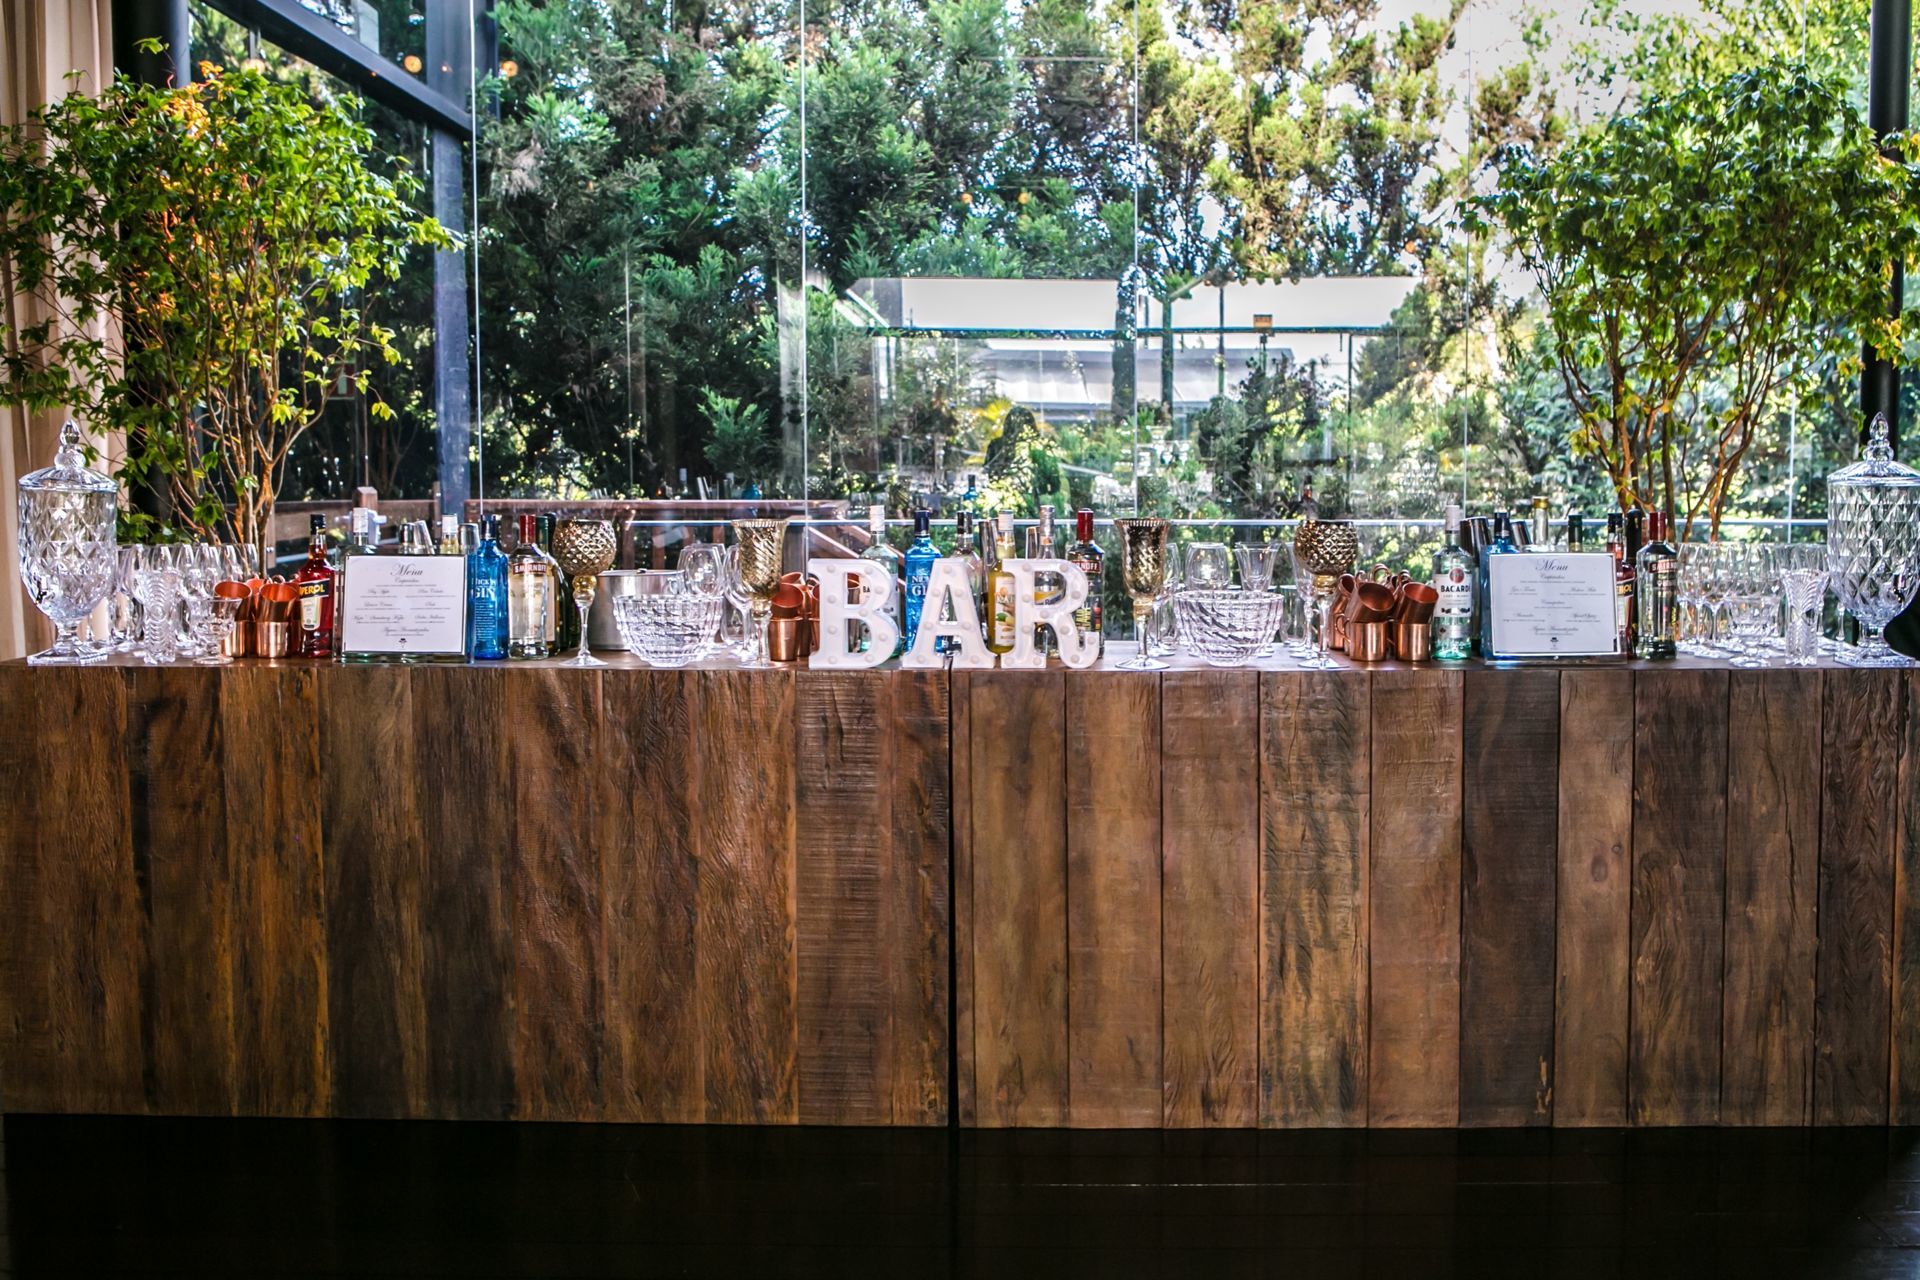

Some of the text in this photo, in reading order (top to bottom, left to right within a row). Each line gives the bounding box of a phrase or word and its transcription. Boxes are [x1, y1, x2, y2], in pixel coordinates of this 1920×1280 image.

[390, 563, 423, 576] Menu
[1535, 560, 1568, 571] Menu
[471, 587, 495, 599] GIN
[808, 558, 1100, 668] BAR
